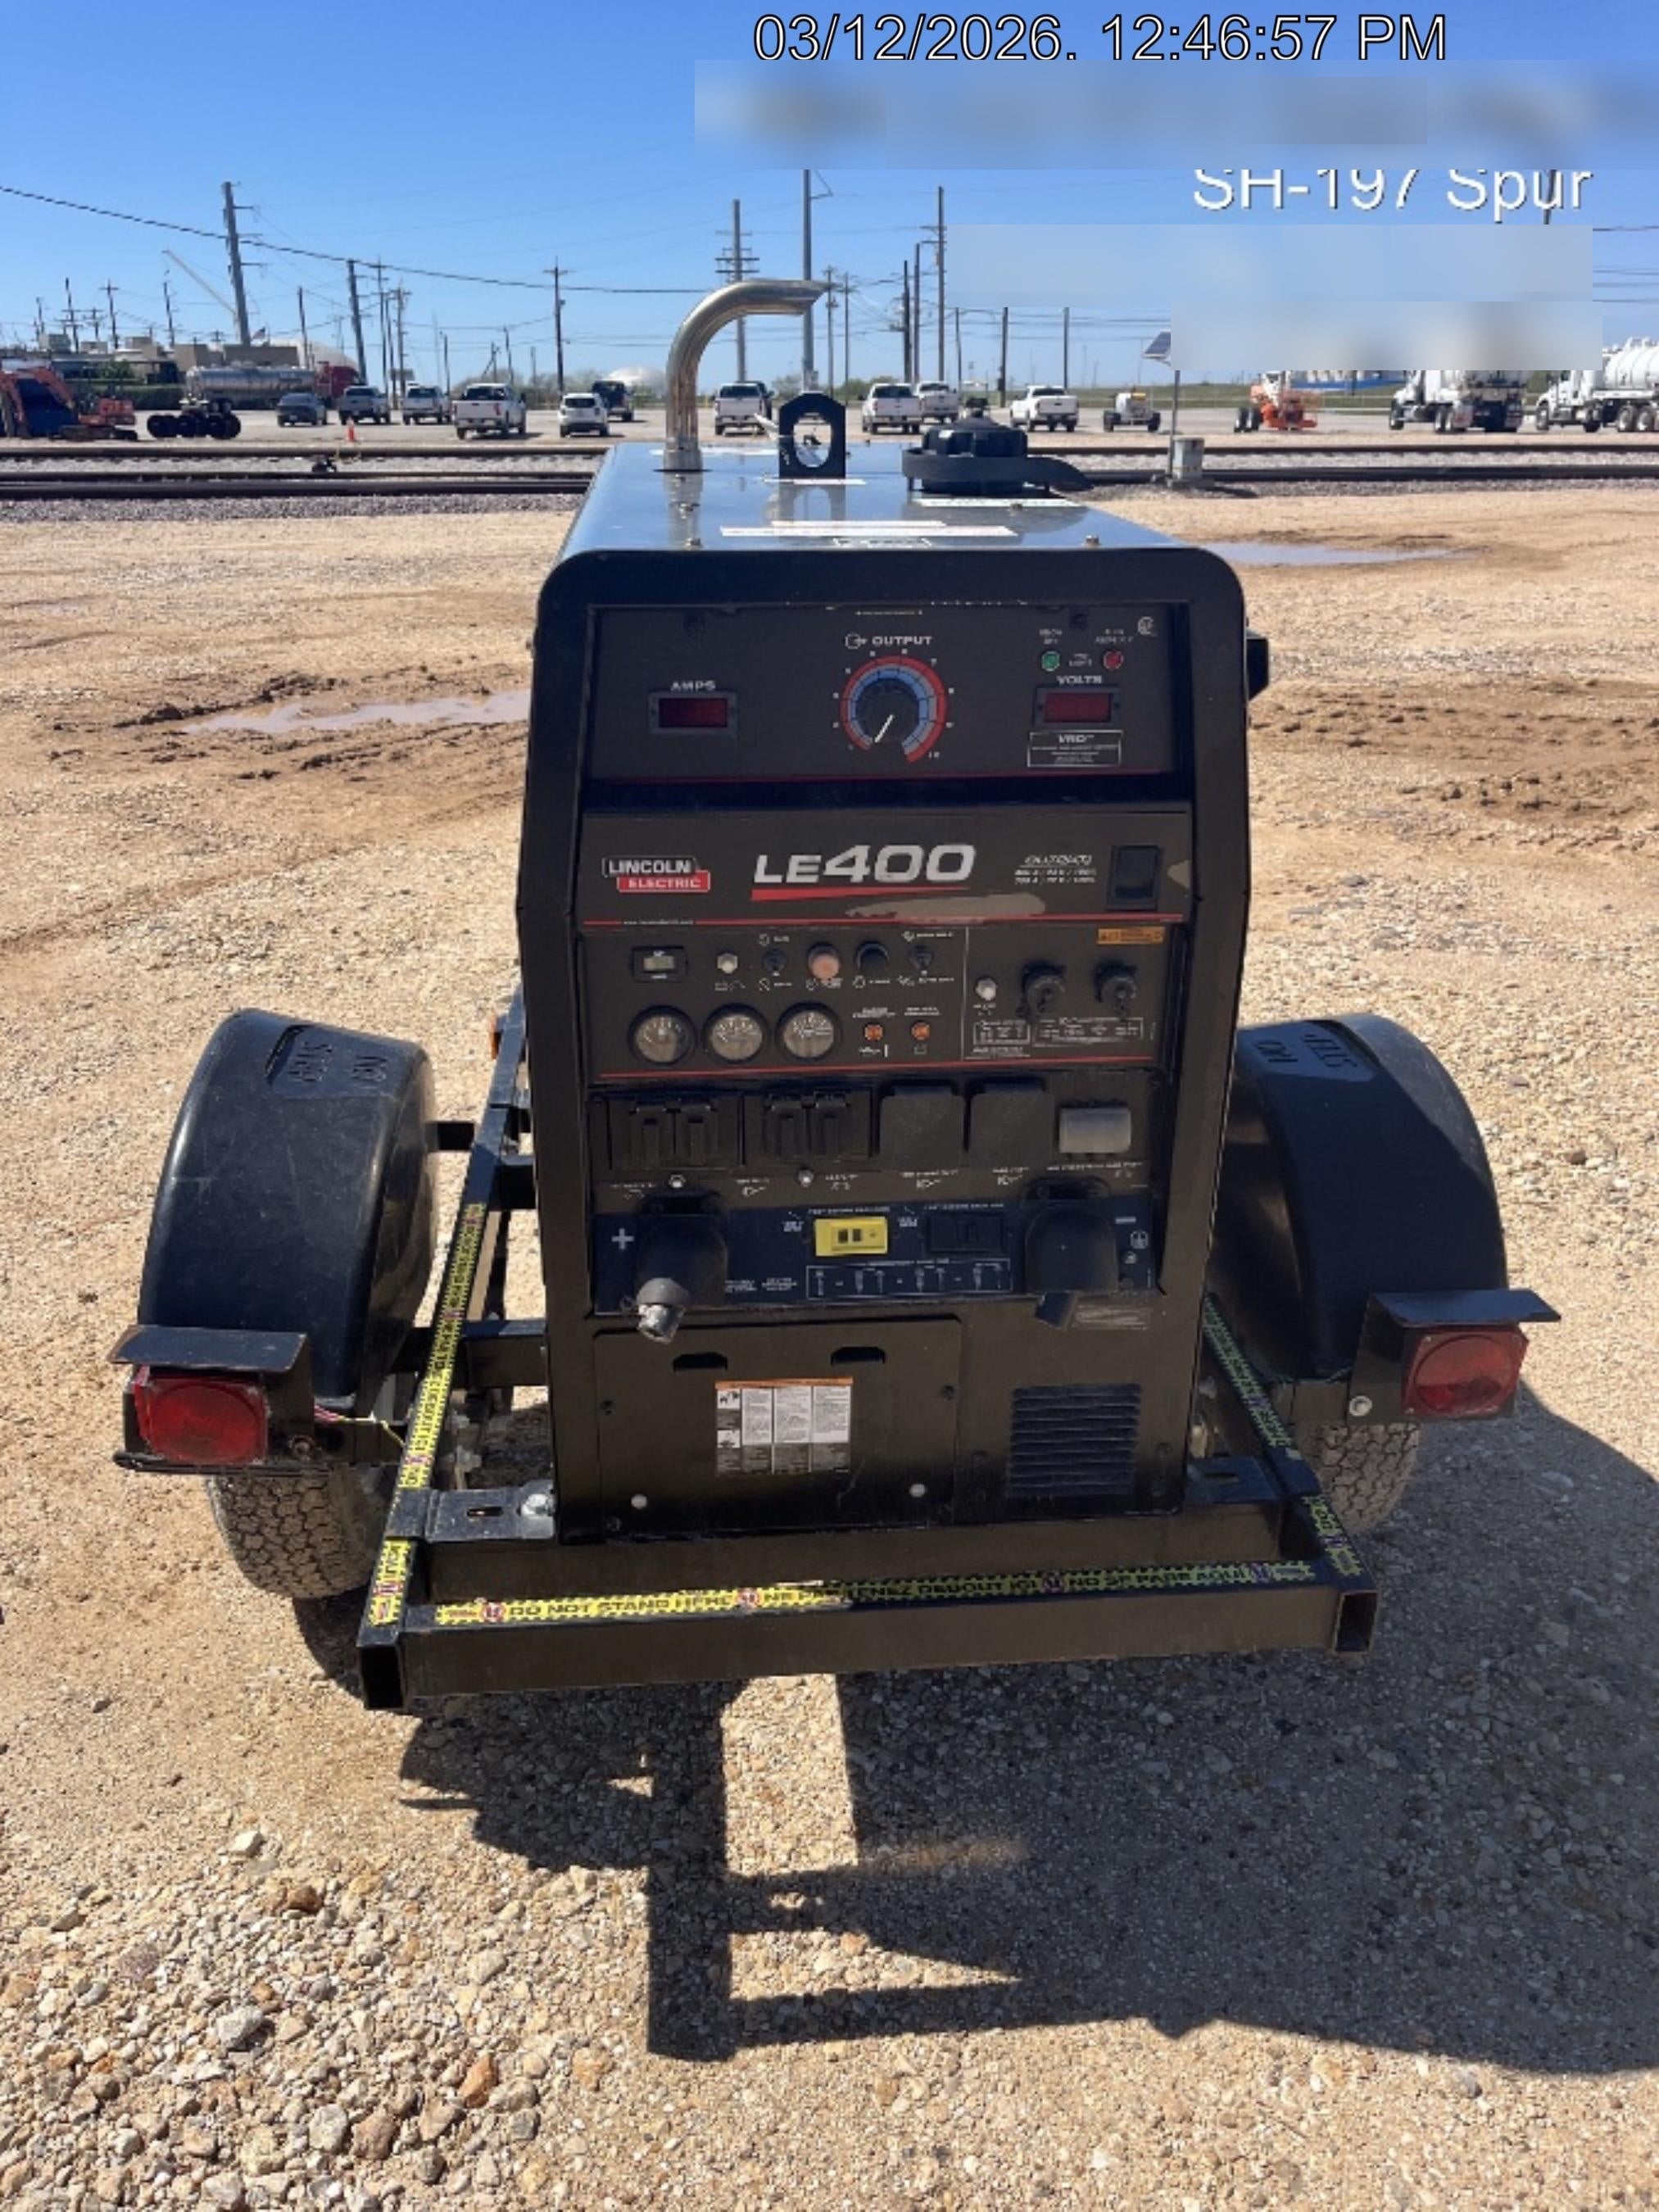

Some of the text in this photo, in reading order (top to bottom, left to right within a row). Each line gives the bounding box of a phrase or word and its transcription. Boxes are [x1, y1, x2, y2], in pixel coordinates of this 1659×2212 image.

[872, 636, 932, 646] OUTPUT
[670, 680, 715, 691] AMPS
[609, 859, 691, 874] LINCOLN
[753, 844, 976, 884] LE400
[628, 877, 702, 889] ELECTRIC
[510, 1605, 541, 1616] DO
[547, 1604, 589, 1615] NOT
[597, 1599, 669, 1612] STAND
